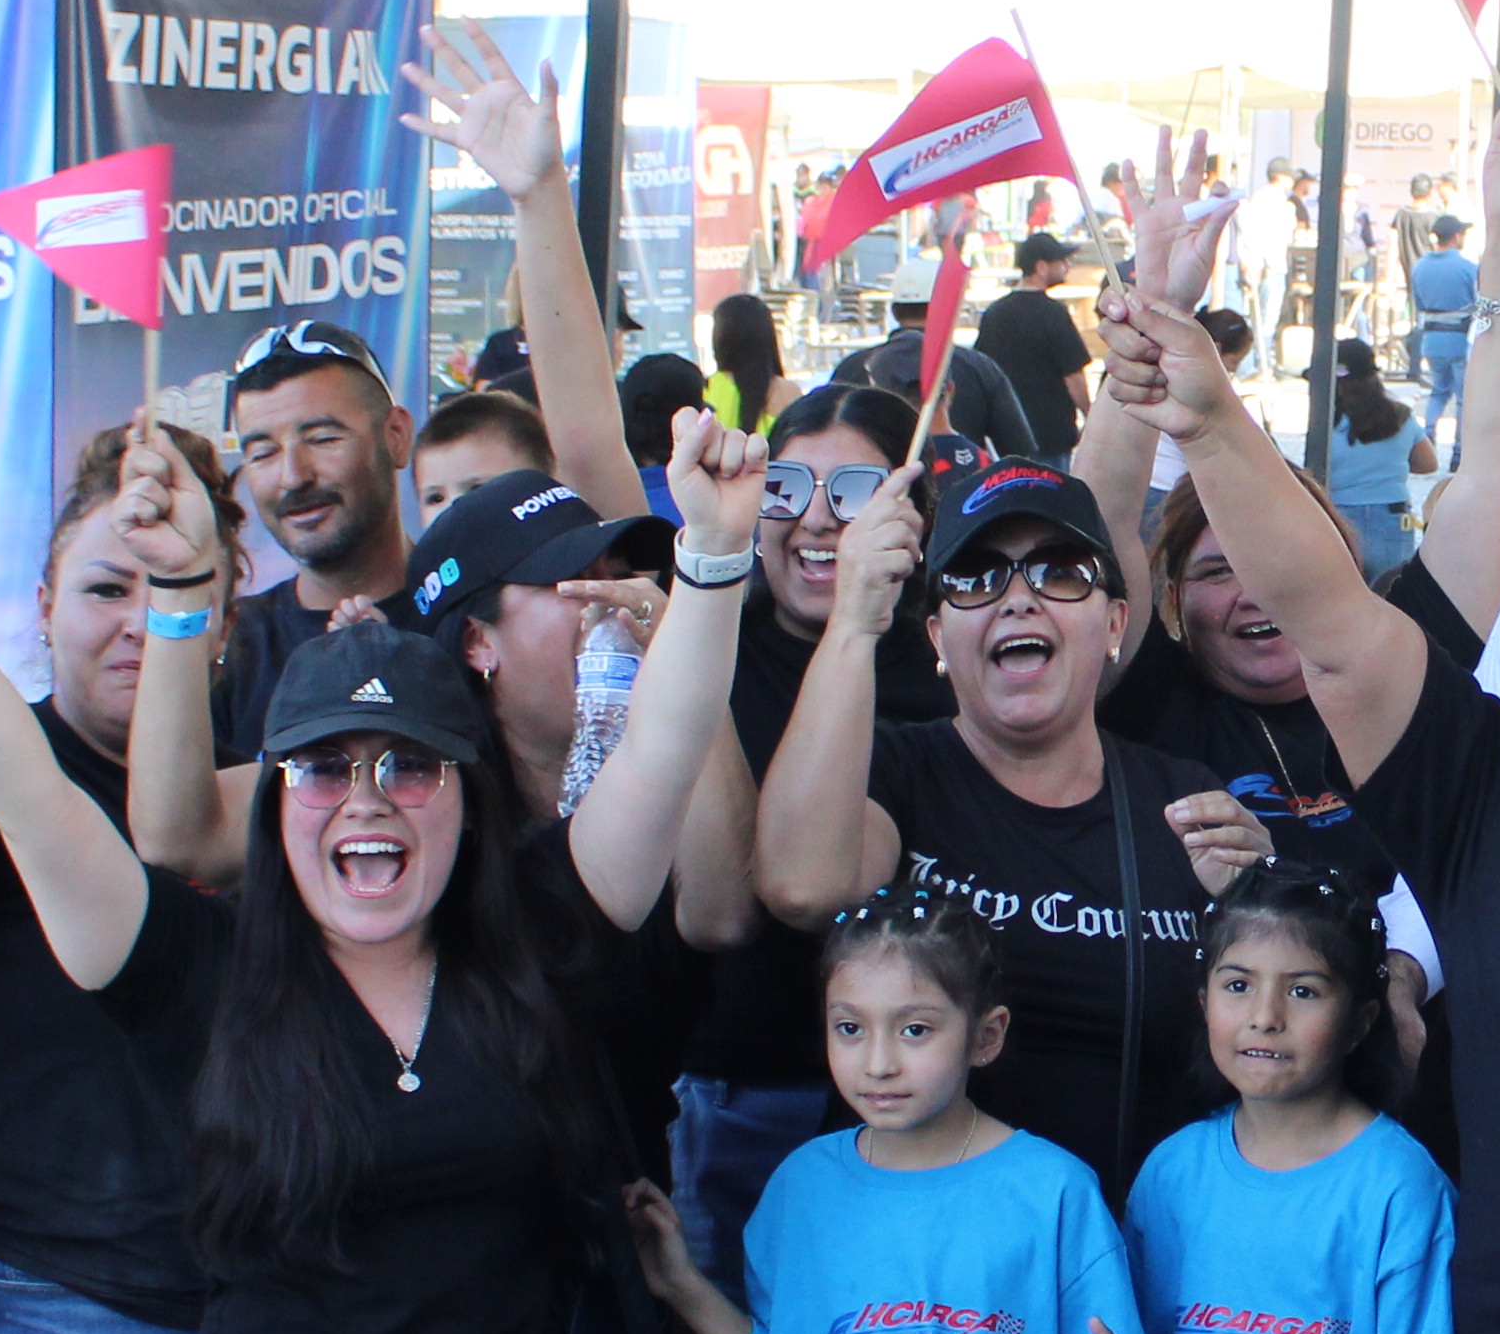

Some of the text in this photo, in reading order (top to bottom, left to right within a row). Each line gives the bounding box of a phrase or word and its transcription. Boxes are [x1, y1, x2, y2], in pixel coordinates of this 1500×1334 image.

[106, 11, 390, 95] ZINERGIA
[1355, 121, 1434, 142] DIREGO
[305, 188, 397, 225] OFICIAL
[351, 693, 393, 704] adidas
[852, 1300, 999, 1334] HCARGA
